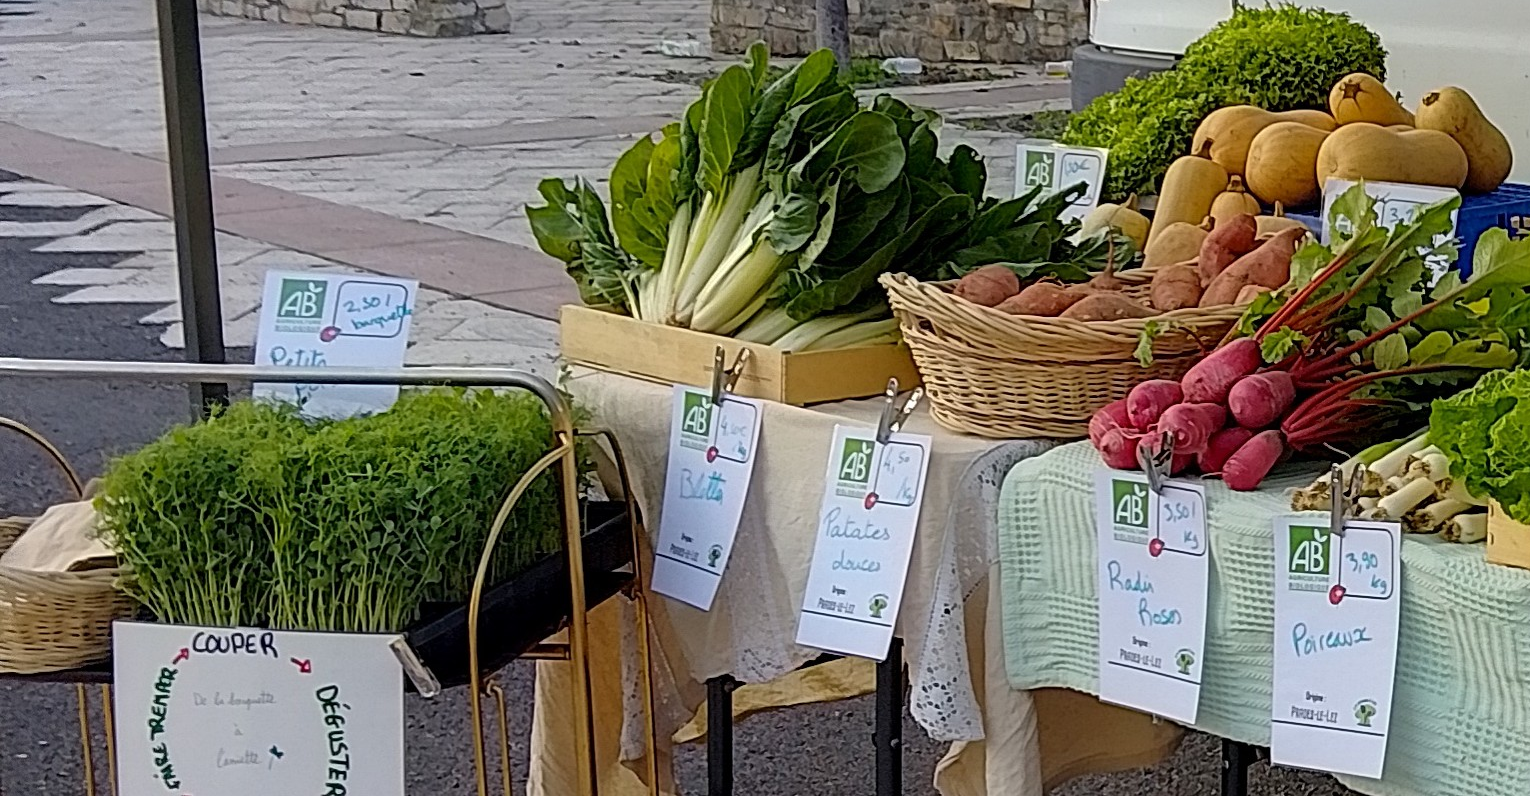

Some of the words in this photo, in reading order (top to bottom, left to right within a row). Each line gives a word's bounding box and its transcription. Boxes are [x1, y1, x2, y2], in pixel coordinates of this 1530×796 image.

[1027, 162, 1050, 186] AB
[280, 290, 318, 317] AB
[683, 405, 708, 434] AB
[841, 451, 867, 481] AB
[822, 506, 891, 541] Patates
[1115, 493, 1145, 526] AB
[831, 549, 882, 573] douces
[1291, 540, 1325, 573] AB
[192, 630, 279, 659] COUPER
[1292, 622, 1373, 658] Poireaux
